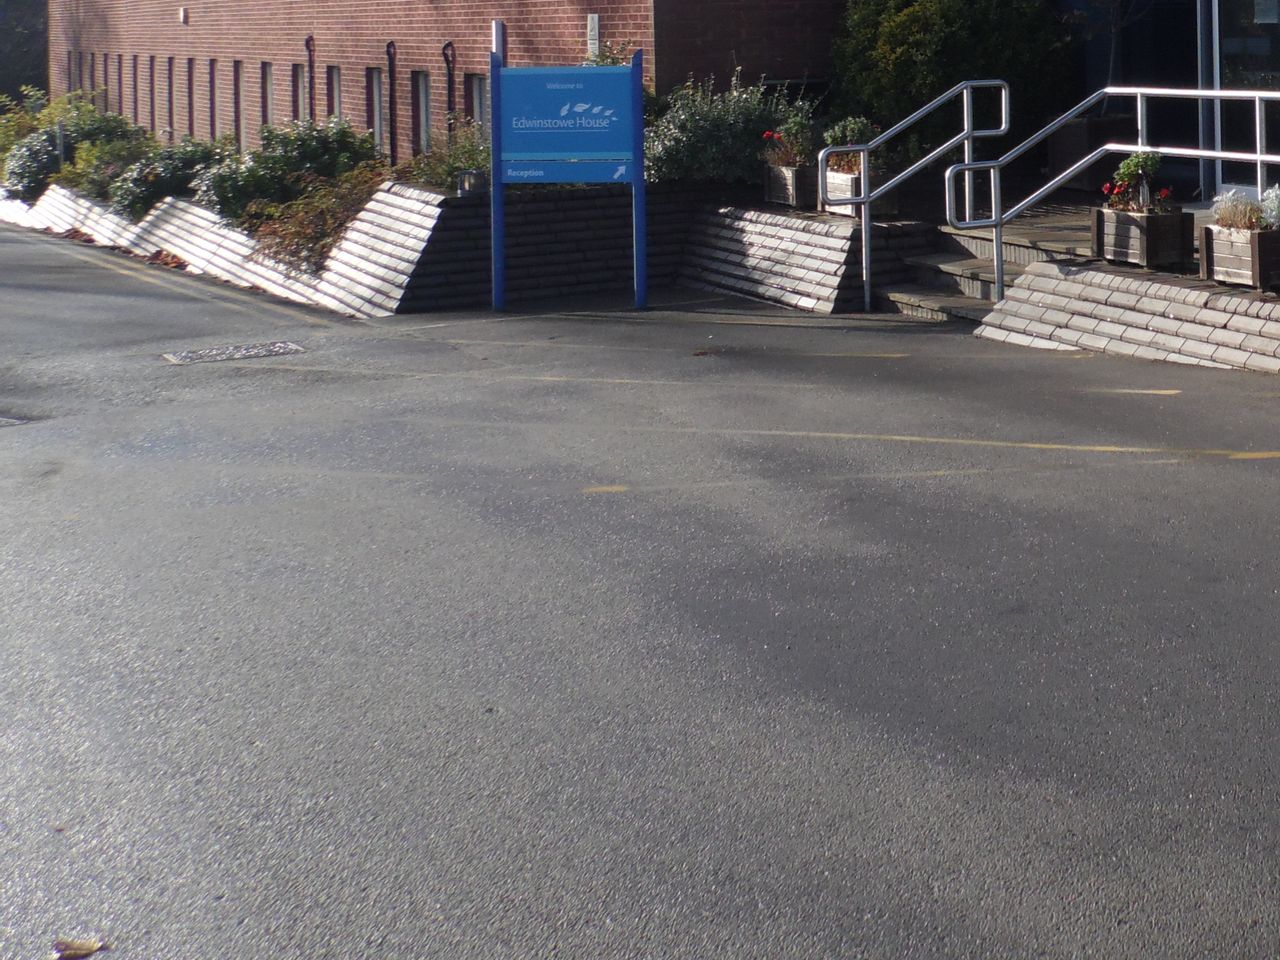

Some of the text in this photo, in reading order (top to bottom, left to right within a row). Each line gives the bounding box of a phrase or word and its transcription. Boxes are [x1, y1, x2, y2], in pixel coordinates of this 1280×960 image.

[512, 117, 609, 128] Edwinstowe House
[507, 169, 544, 178] Reception
